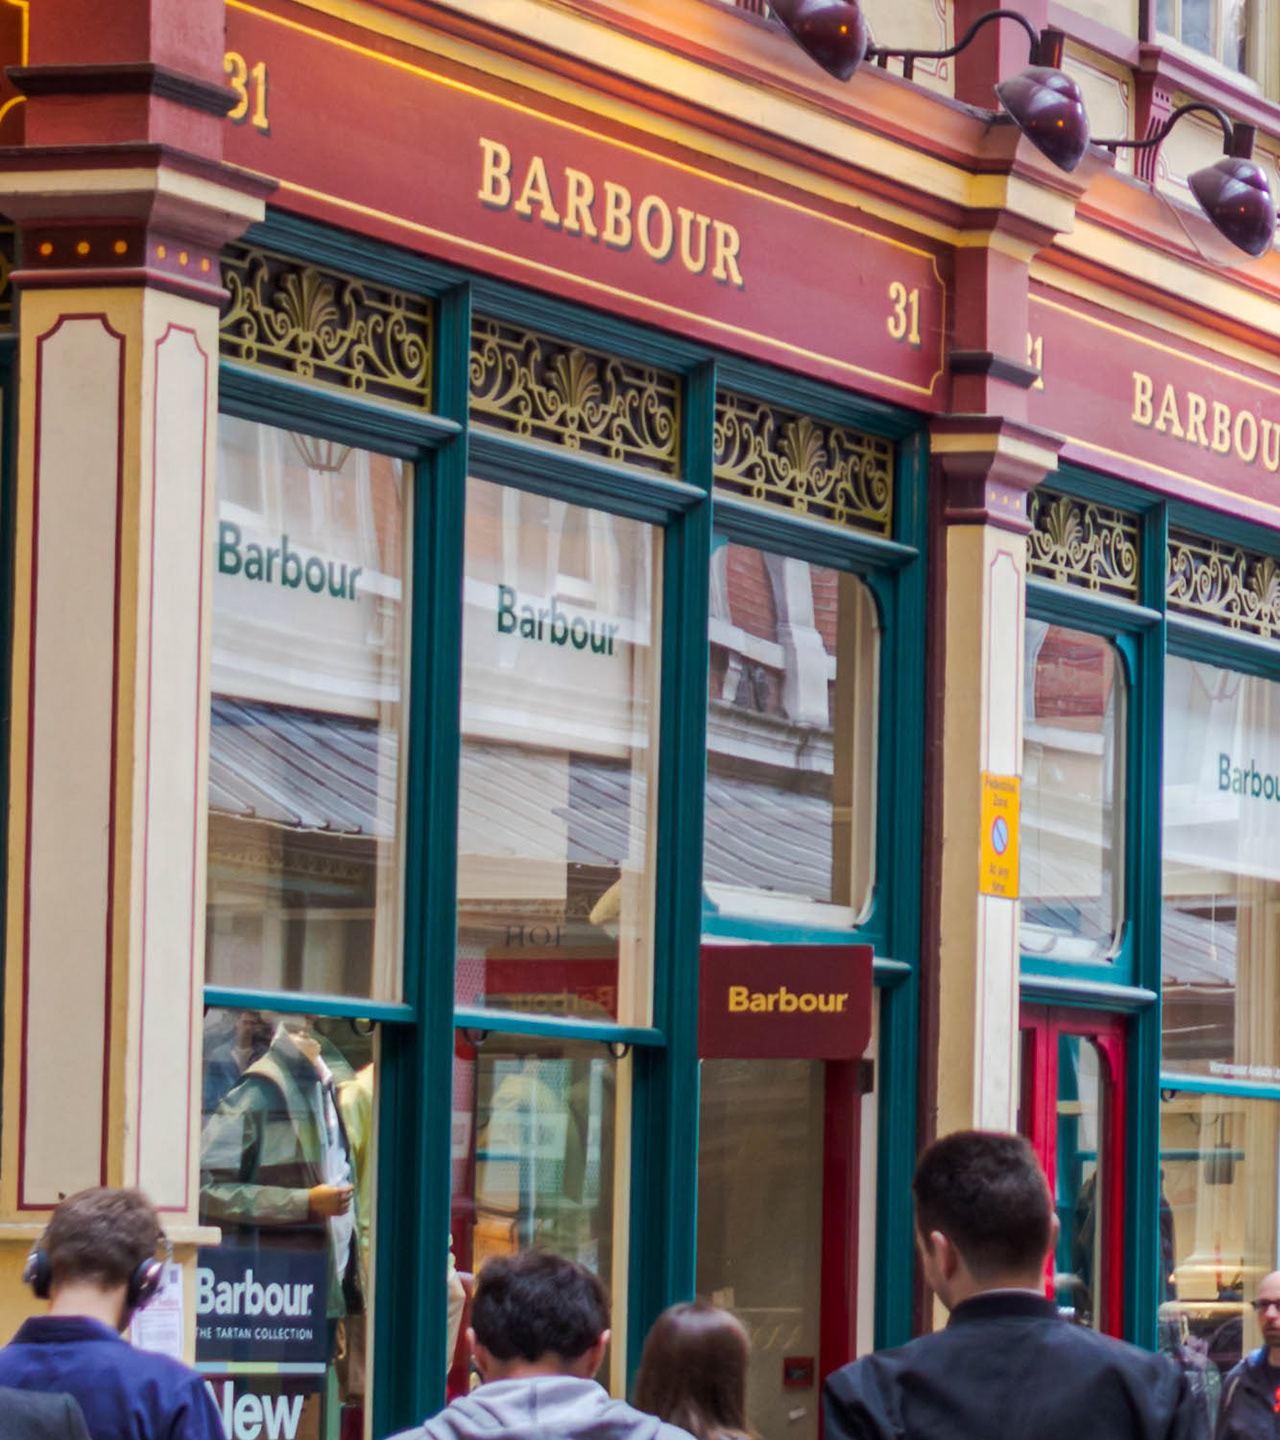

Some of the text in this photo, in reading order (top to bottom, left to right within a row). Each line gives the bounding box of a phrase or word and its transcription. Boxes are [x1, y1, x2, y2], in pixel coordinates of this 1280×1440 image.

[478, 137, 743, 287] BARBOUR
[887, 281, 921, 346] 31
[217, 520, 362, 601] Barbour
[496, 583, 619, 656] Barbour
[728, 986, 849, 1014] Barbour
[196, 1267, 314, 1316] Barbour
[216, 1327, 252, 1340] TARTAN
[255, 1328, 313, 1341] COLLECTION
